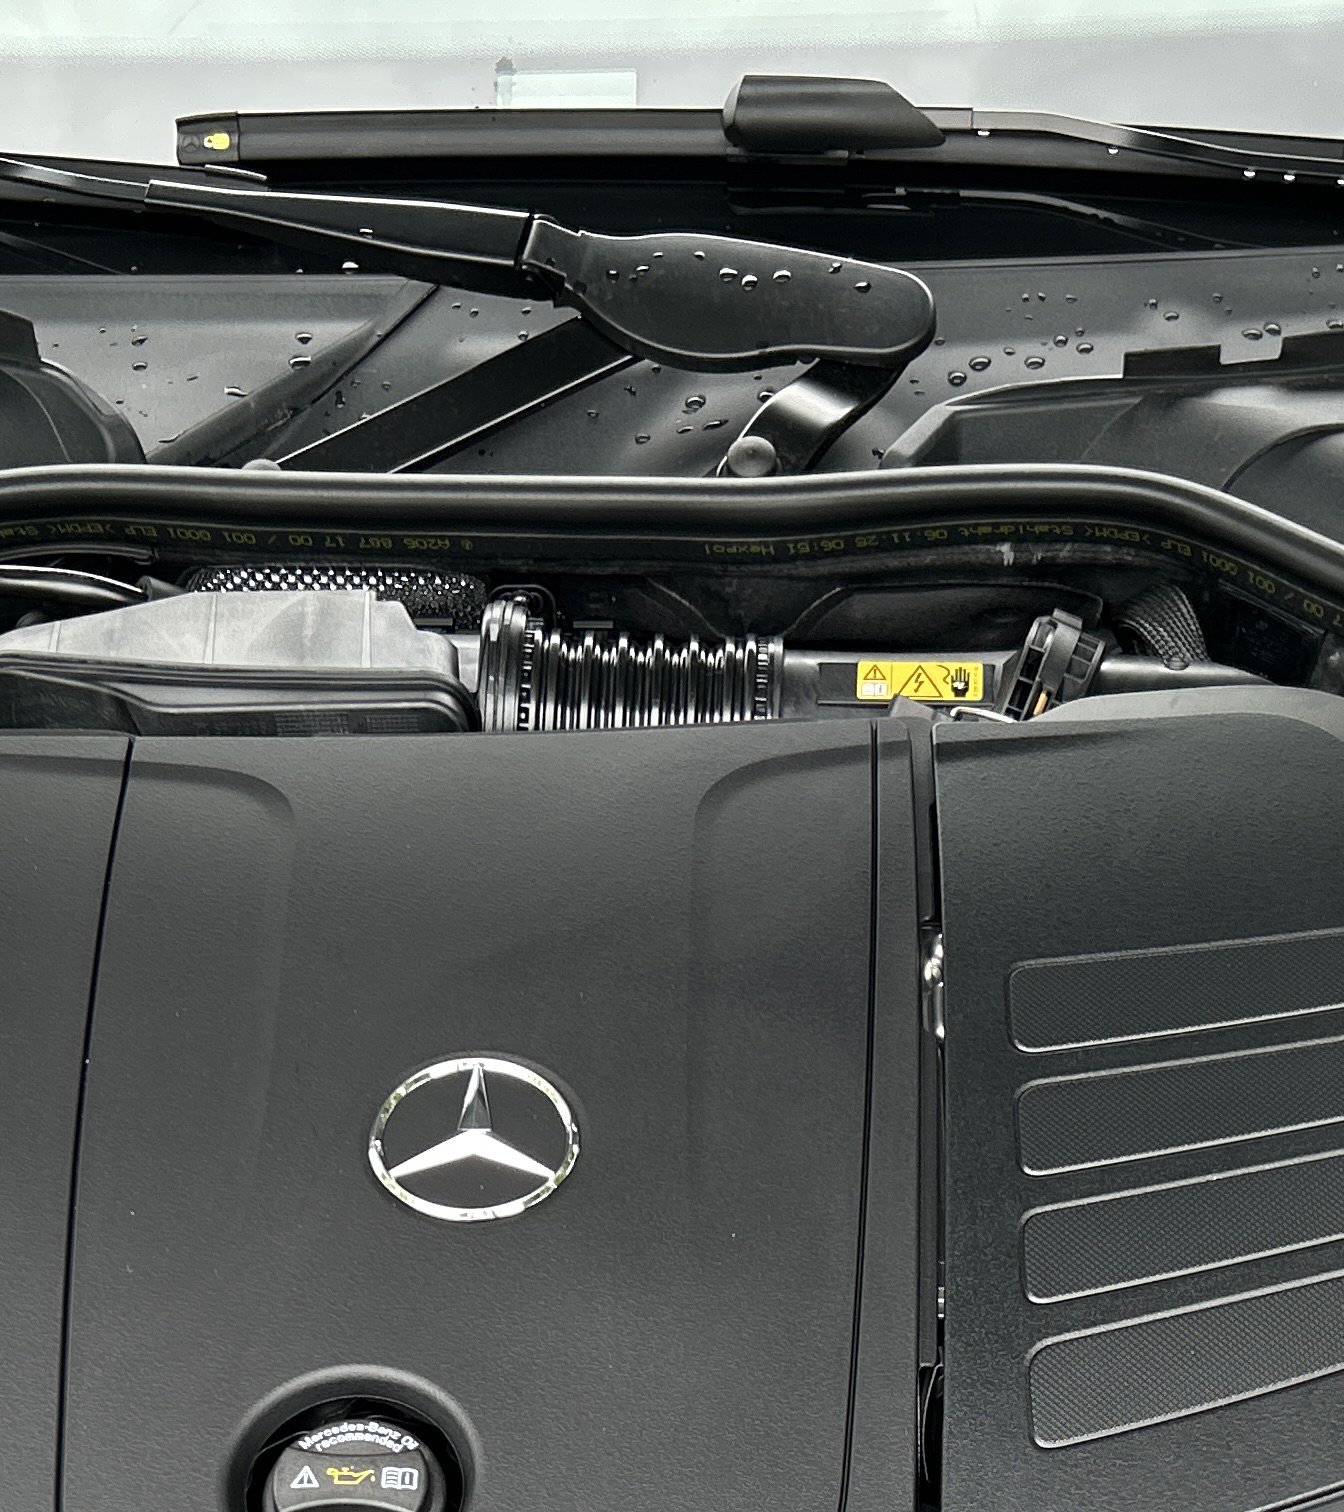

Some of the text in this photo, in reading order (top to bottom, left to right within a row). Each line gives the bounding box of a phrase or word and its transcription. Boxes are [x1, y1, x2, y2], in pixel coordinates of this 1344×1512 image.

[298, 1422, 420, 1451] Mercedes-Benz Oil
[315, 1432, 404, 1453] recommended
